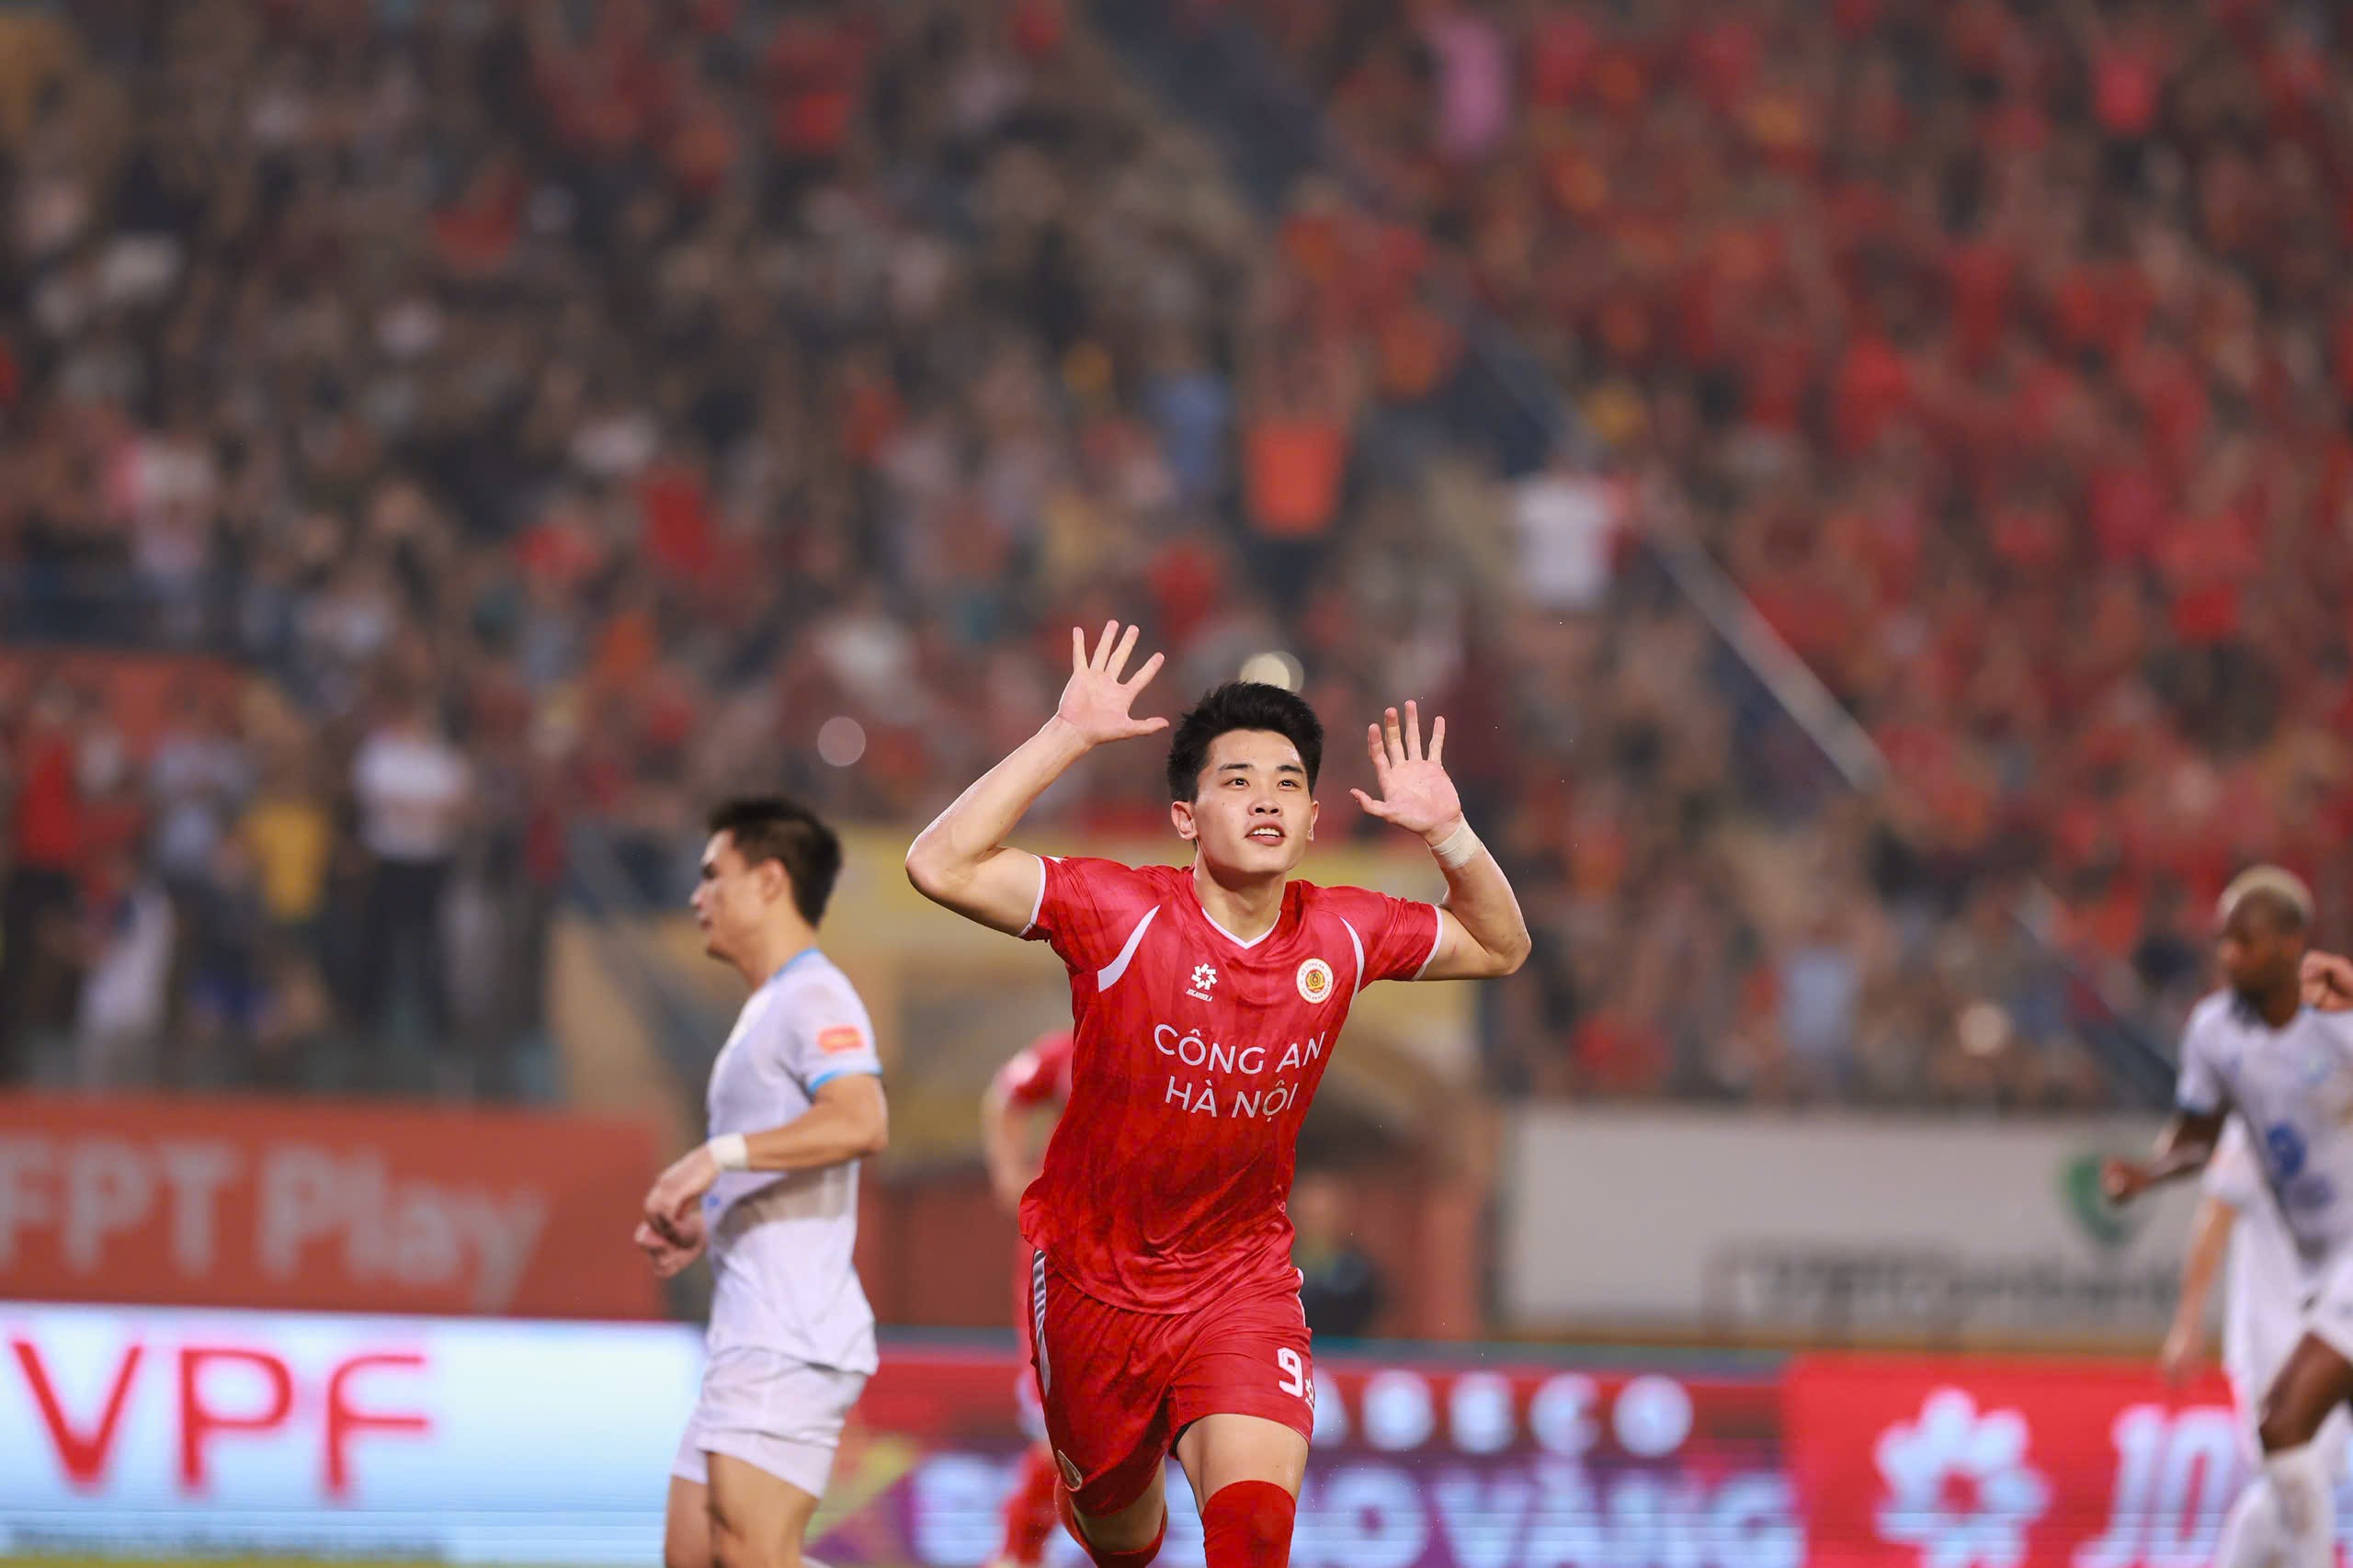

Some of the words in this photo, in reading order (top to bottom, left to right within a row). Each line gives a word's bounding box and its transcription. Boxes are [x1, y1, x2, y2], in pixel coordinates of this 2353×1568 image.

[1154, 1024, 1266, 1074] CÔNG
[1275, 1031, 1325, 1073] AN
[1165, 1075, 1217, 1118] HÀ
[1232, 1079, 1299, 1122] NỘI
[0, 1131, 244, 1276] FPT
[259, 1136, 550, 1309] Play
[1277, 1347, 1303, 1397] 9
[11, 1338, 430, 1496] VPF
